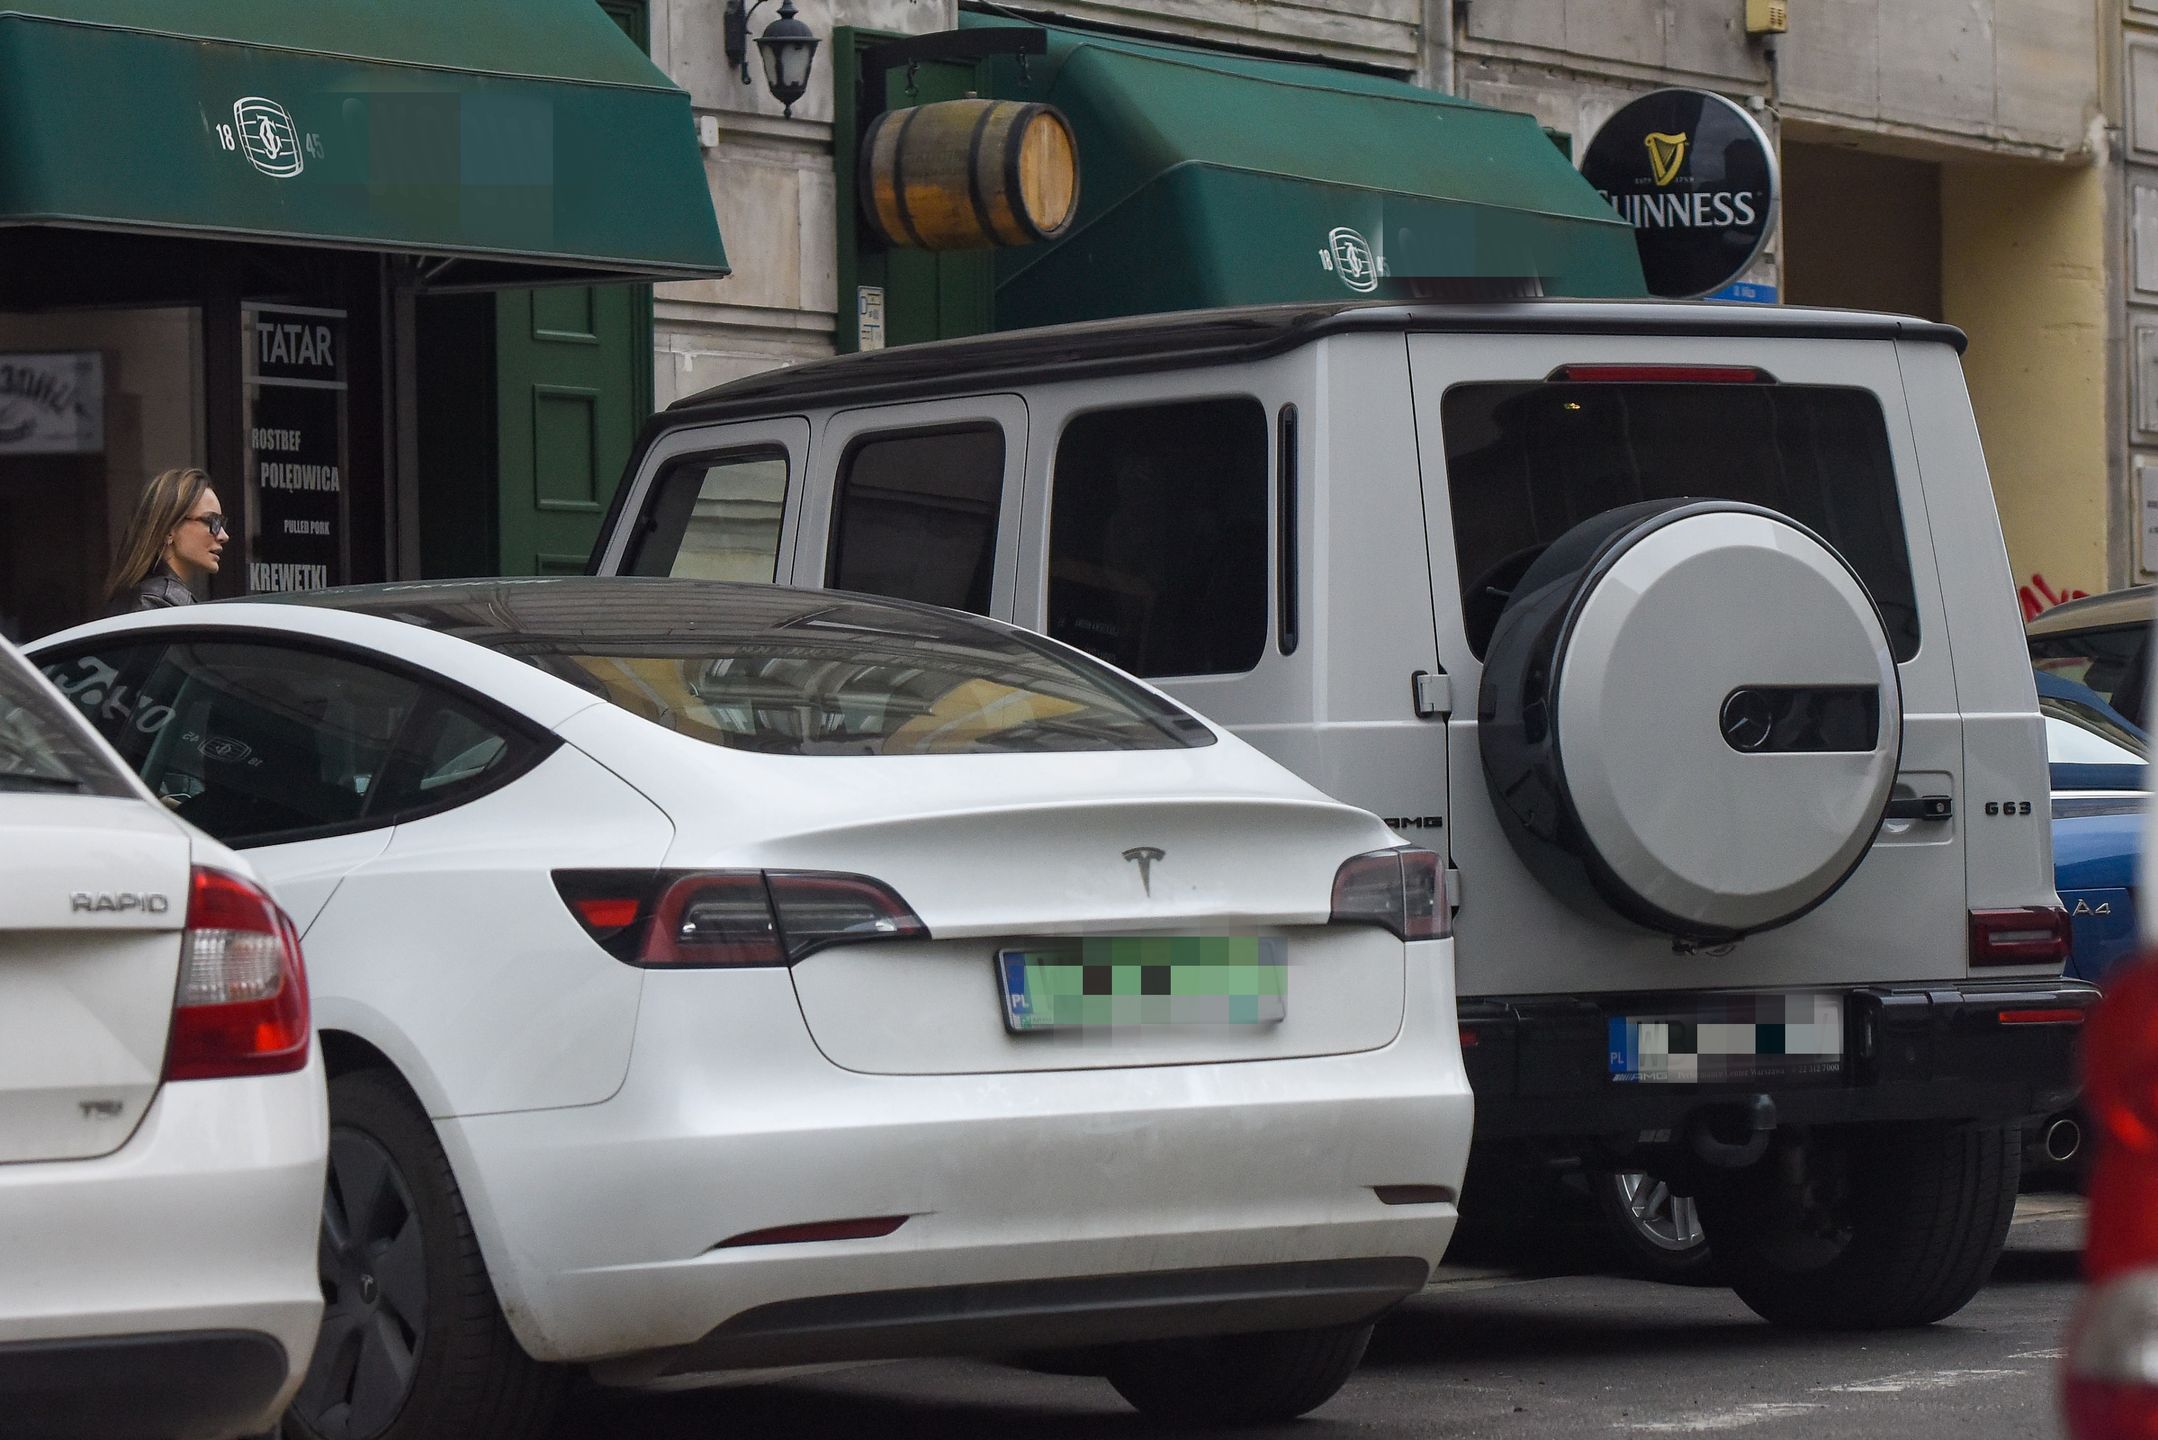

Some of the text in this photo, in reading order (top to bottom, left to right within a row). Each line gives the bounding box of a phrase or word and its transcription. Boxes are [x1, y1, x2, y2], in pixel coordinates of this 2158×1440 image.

[215, 123, 326, 160] 18 45
[1597, 190, 1756, 229] UINNESS
[1318, 248, 1334, 271] 18
[255, 322, 334, 367] TATAR
[252, 427, 302, 452] ROSTBEF
[260, 461, 340, 494] POLĘDWICA
[283, 519, 331, 535] PULLED PORK
[249, 562, 328, 592] KREWETKI
[1382, 815, 1443, 829] AMG
[71, 891, 169, 913] RAPID
[2072, 898, 2111, 916] A4
[1011, 994, 1030, 1009] PL
[1610, 1052, 1625, 1065] PL
